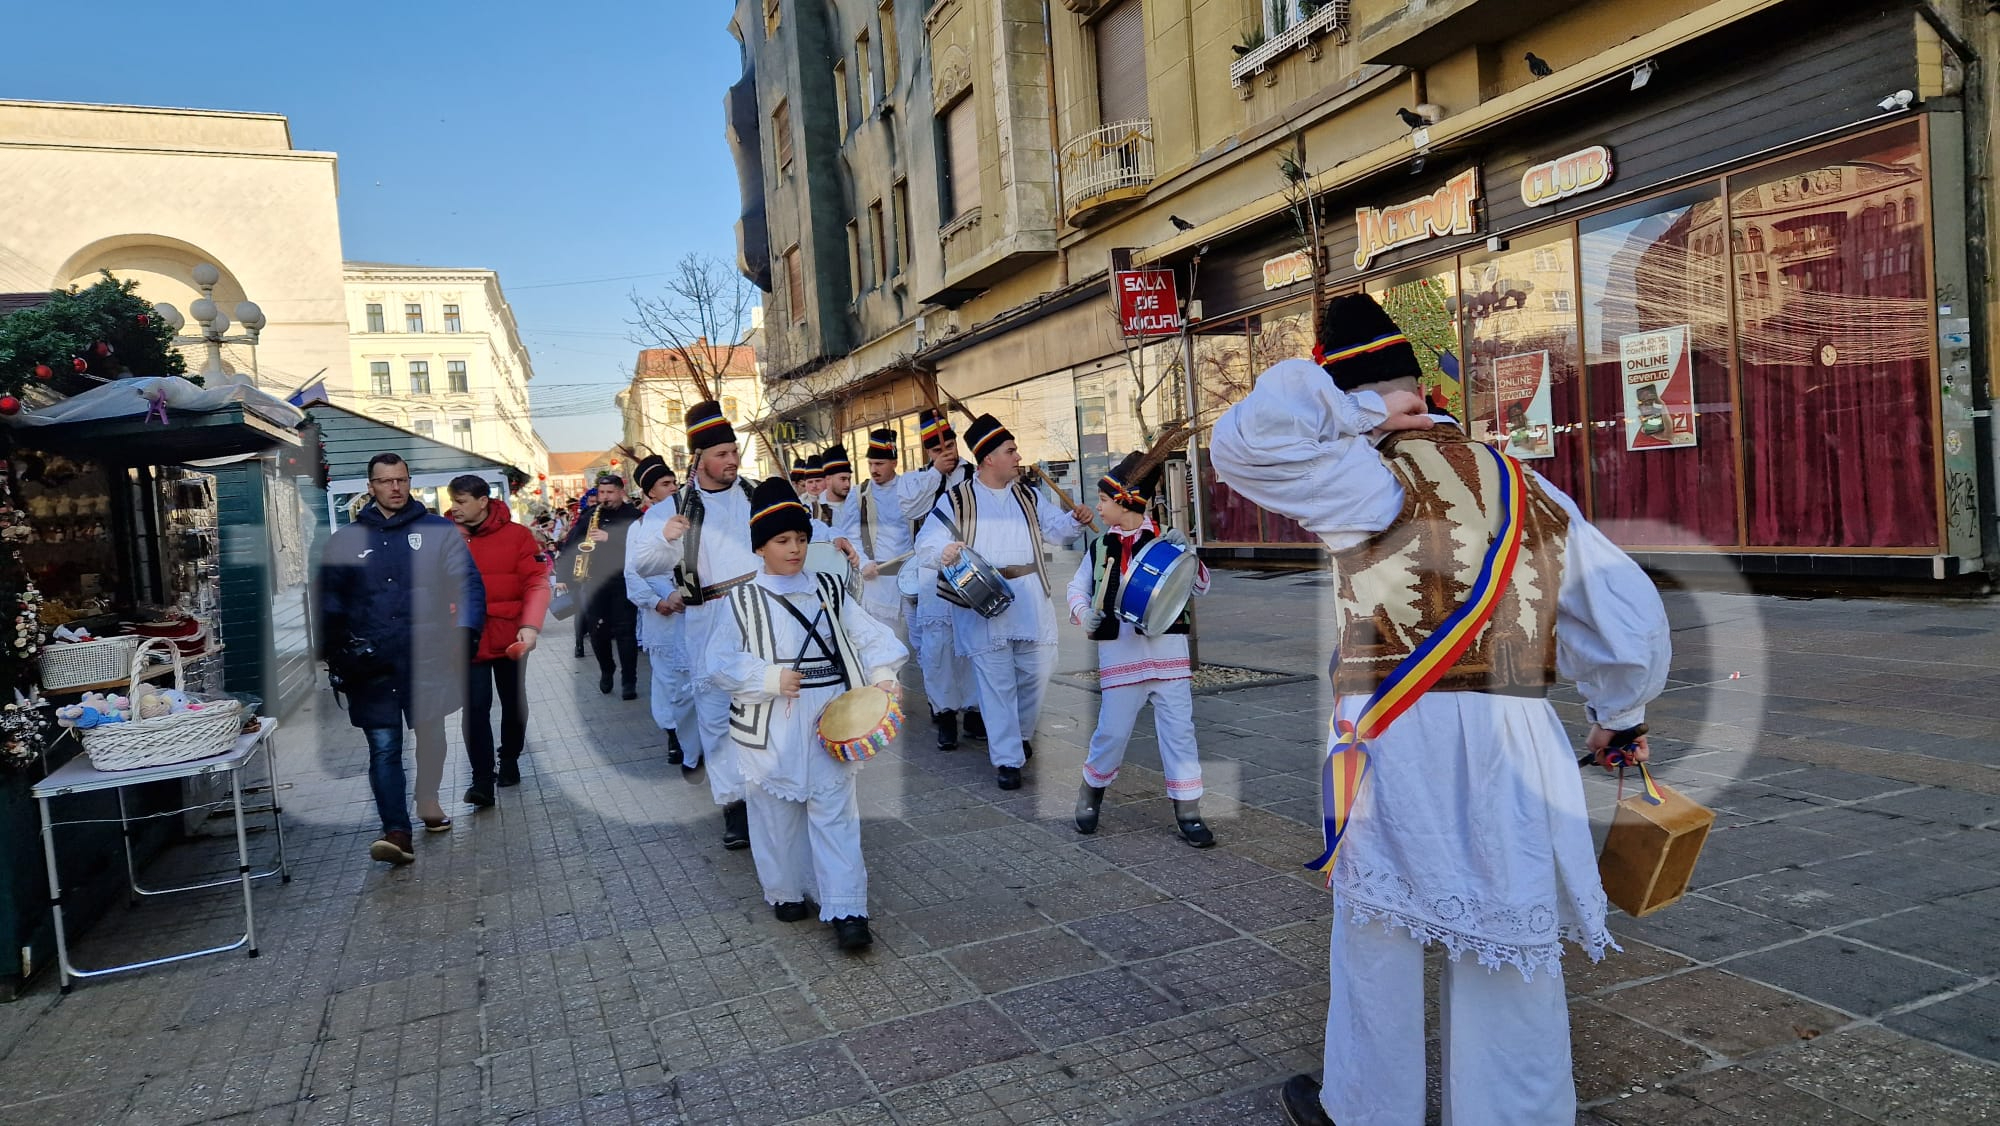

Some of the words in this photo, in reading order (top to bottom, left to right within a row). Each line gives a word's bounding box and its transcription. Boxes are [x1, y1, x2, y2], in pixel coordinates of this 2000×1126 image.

[1264, 251, 1314, 288] SUPE
[1355, 173, 1474, 268] JACKPOT
[1524, 150, 1604, 203] CLUB
[1124, 276, 1167, 292] SALA
[1136, 295, 1159, 310] DE
[1123, 313, 1179, 331] JOCURI
[1627, 354, 1669, 370] ONLINE
[1498, 375, 1532, 388] ONLINE
[1628, 370, 1669, 383] seven.ro
[1500, 390, 1532, 400] seven.ro
